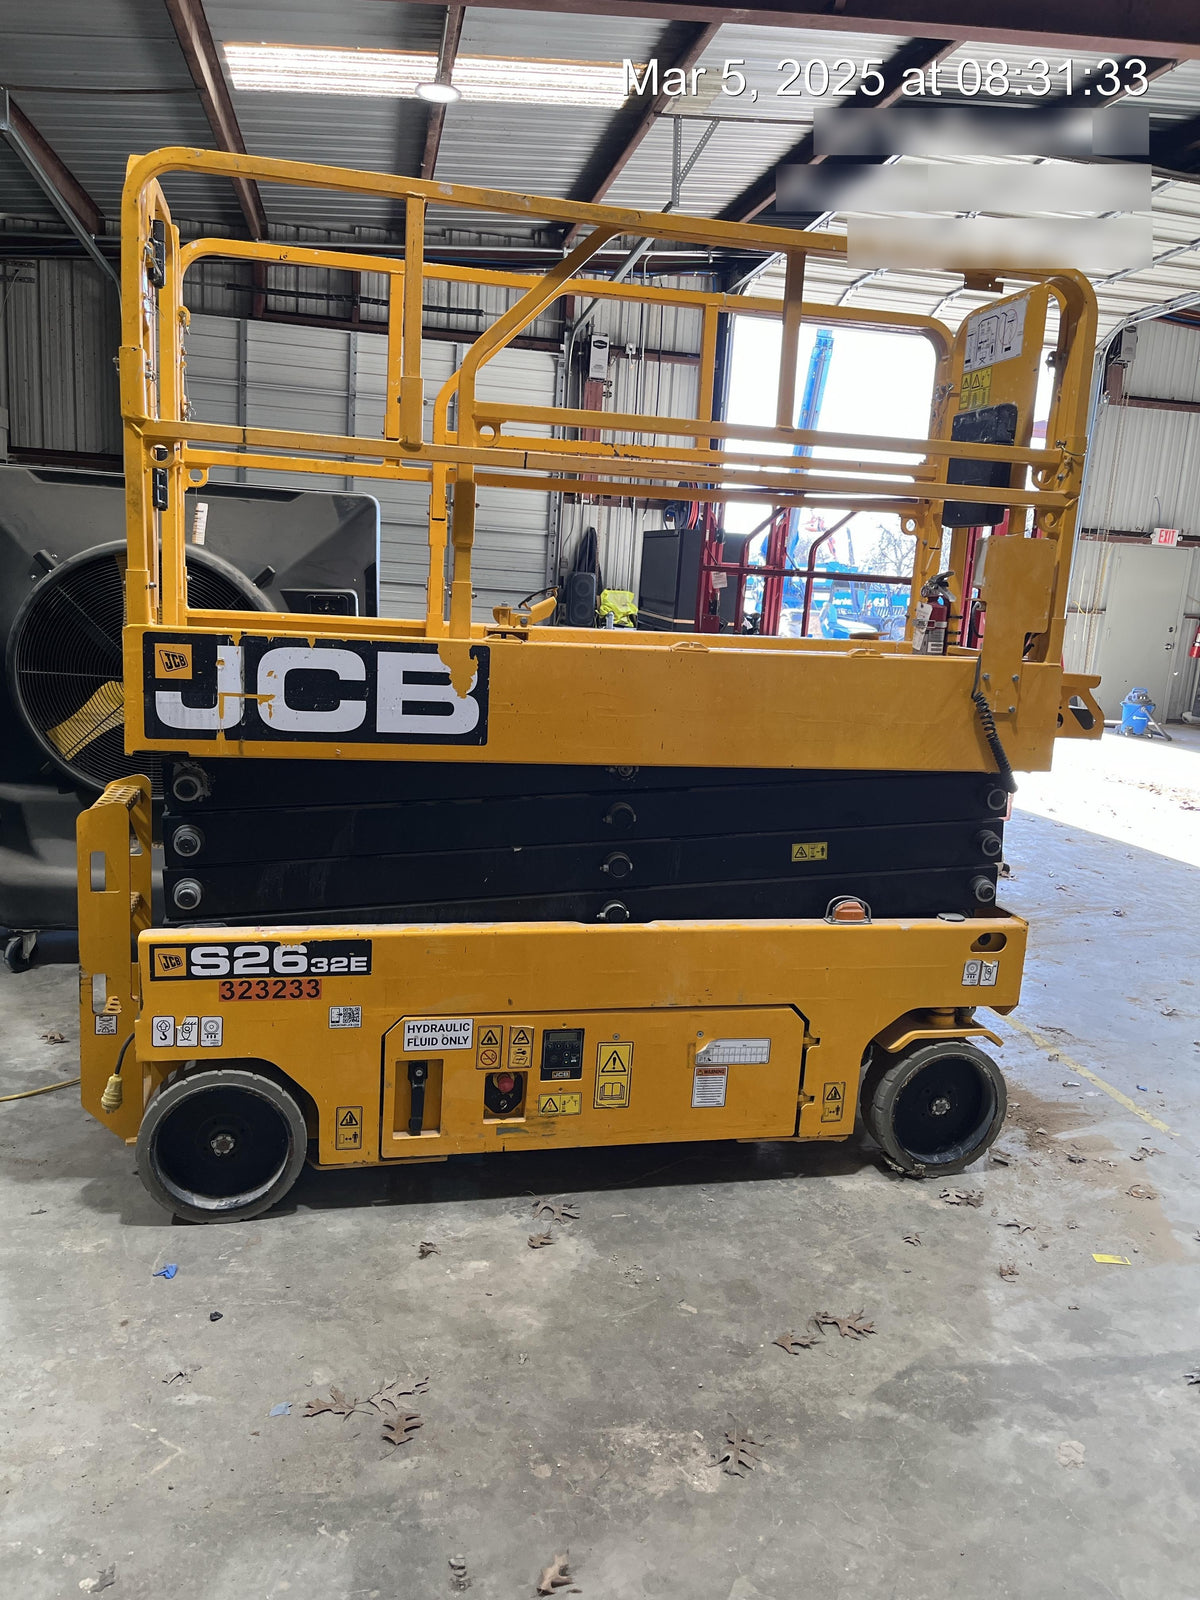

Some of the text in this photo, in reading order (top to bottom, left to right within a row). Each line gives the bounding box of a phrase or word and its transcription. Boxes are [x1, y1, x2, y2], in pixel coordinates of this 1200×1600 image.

[1158, 529, 1176, 545] EXIT
[164, 652, 187, 670] JCB
[155, 644, 480, 735] JCB
[162, 955, 182, 969] JCB
[221, 979, 320, 1000] 323233
[407, 1022, 470, 1034] HYDRAULIC
[407, 1035, 469, 1047] FLUID ONLY
